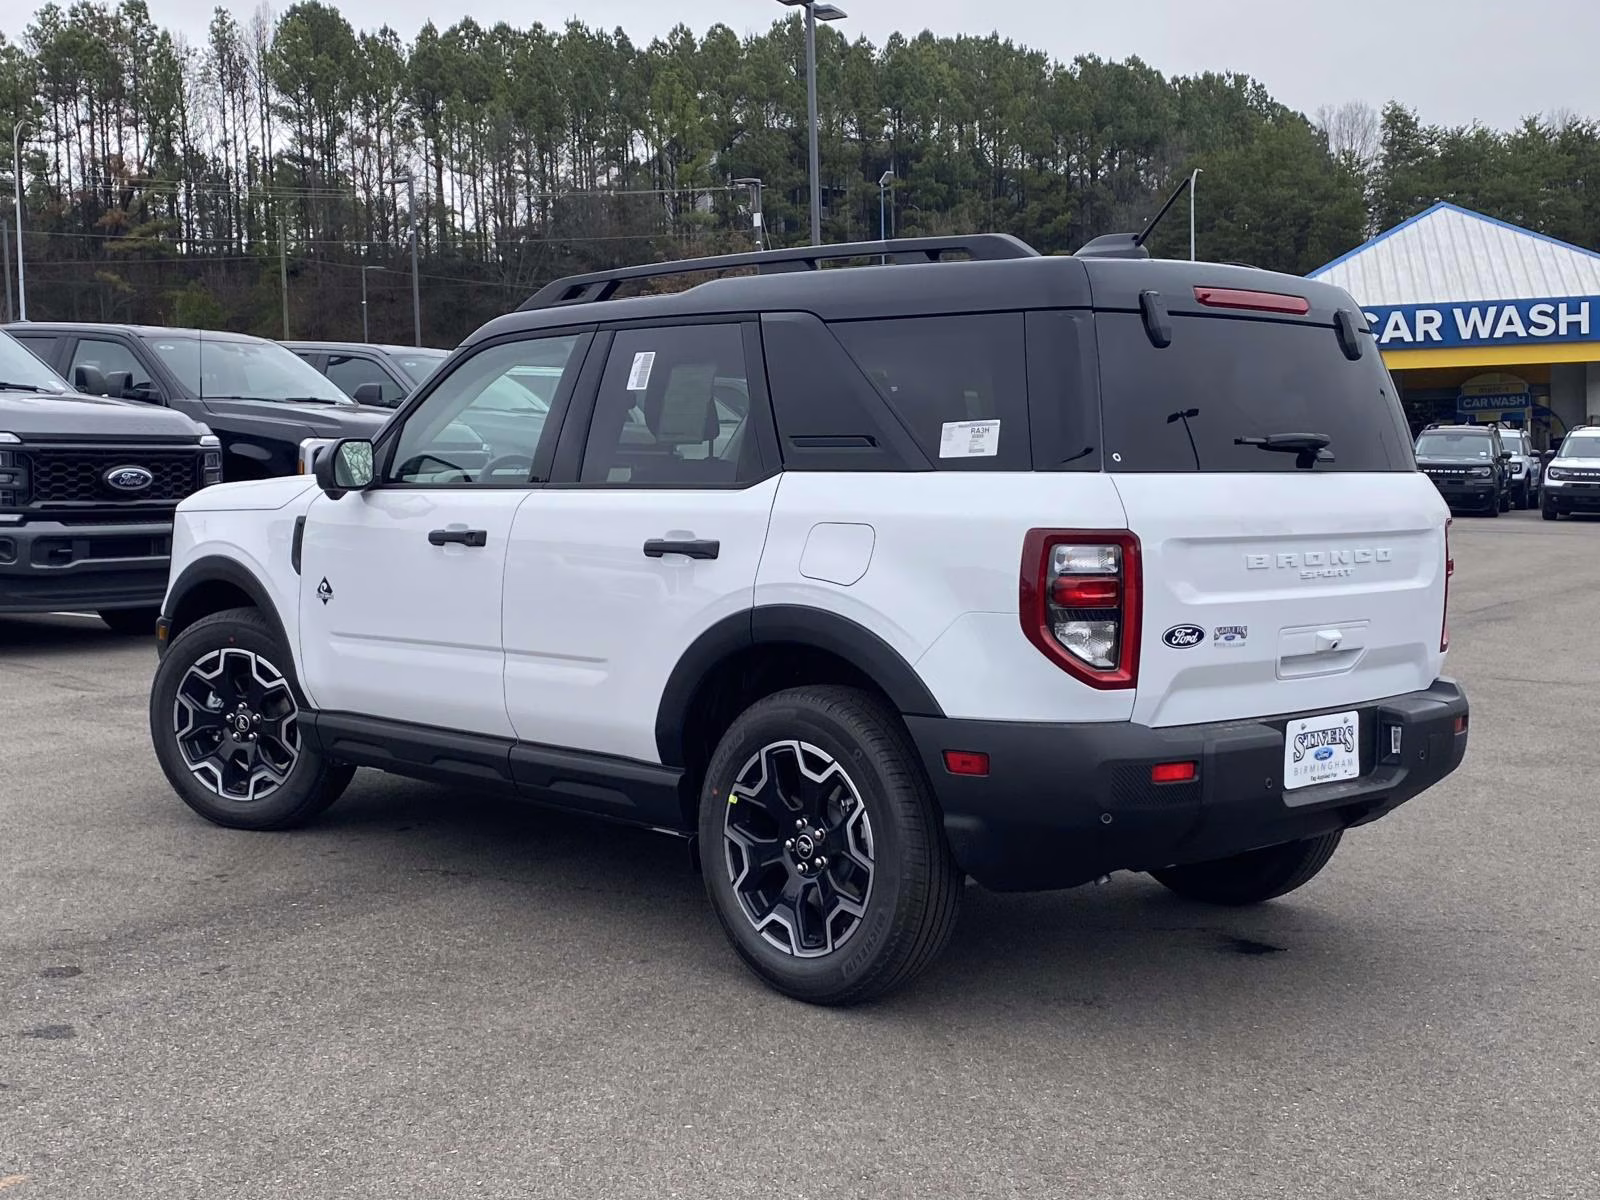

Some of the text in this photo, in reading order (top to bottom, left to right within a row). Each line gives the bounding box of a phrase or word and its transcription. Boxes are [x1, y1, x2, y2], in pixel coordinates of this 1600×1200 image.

[1452, 301, 1590, 340] WASH
[1463, 395, 1526, 408] CAR WASH
[1246, 548, 1392, 570] BRONCO
[1300, 568, 1354, 580] SPORT
[1293, 725, 1355, 764] STIVERS
[1293, 758, 1354, 776] BIRMINGHAM
